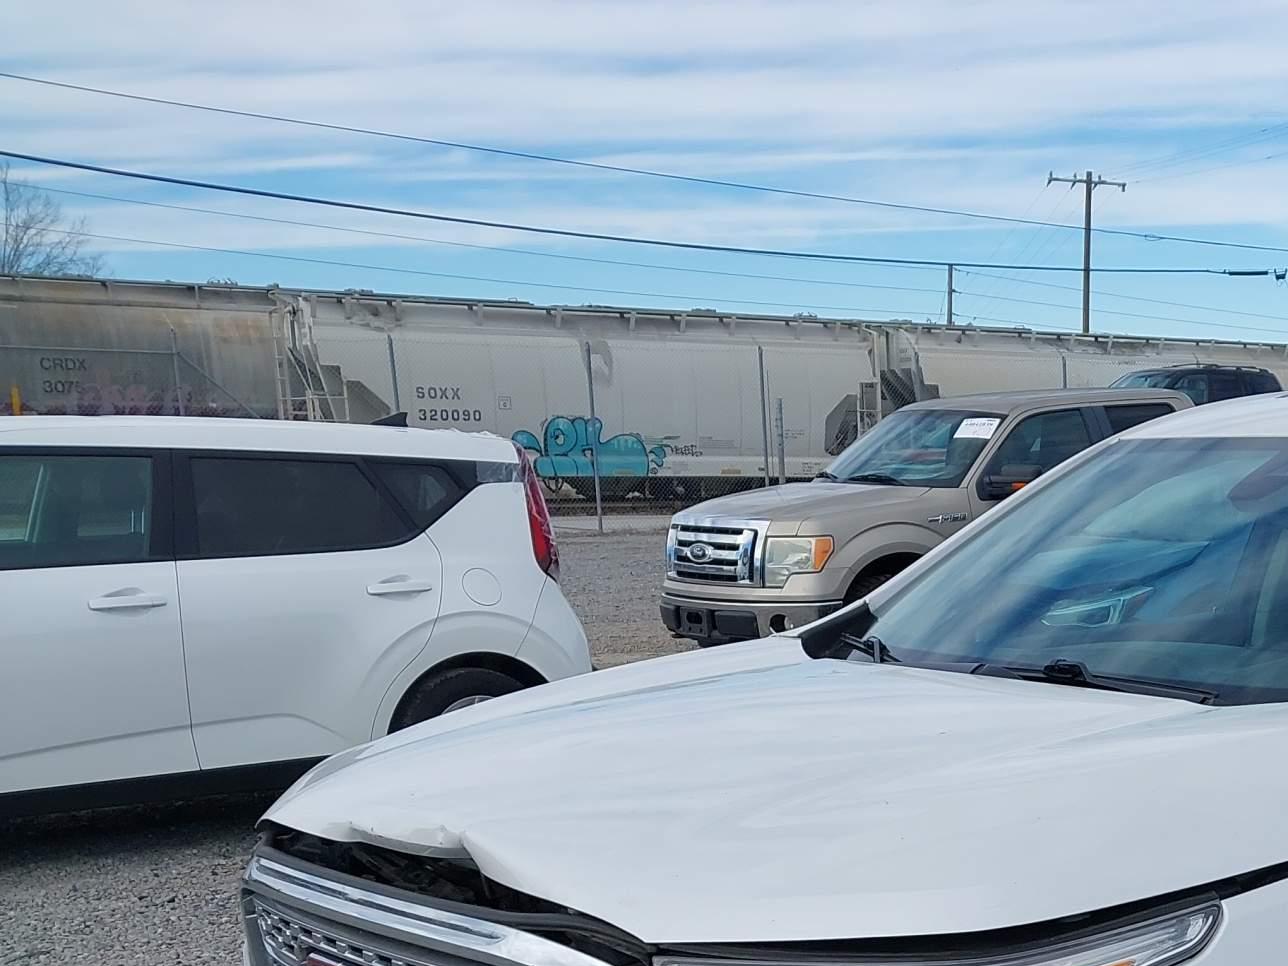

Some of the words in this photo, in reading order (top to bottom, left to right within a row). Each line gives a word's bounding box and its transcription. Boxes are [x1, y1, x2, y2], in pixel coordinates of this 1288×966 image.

[40, 357, 88, 371] CRDX
[415, 386, 461, 400] SOXX
[418, 408, 482, 422] 320090
